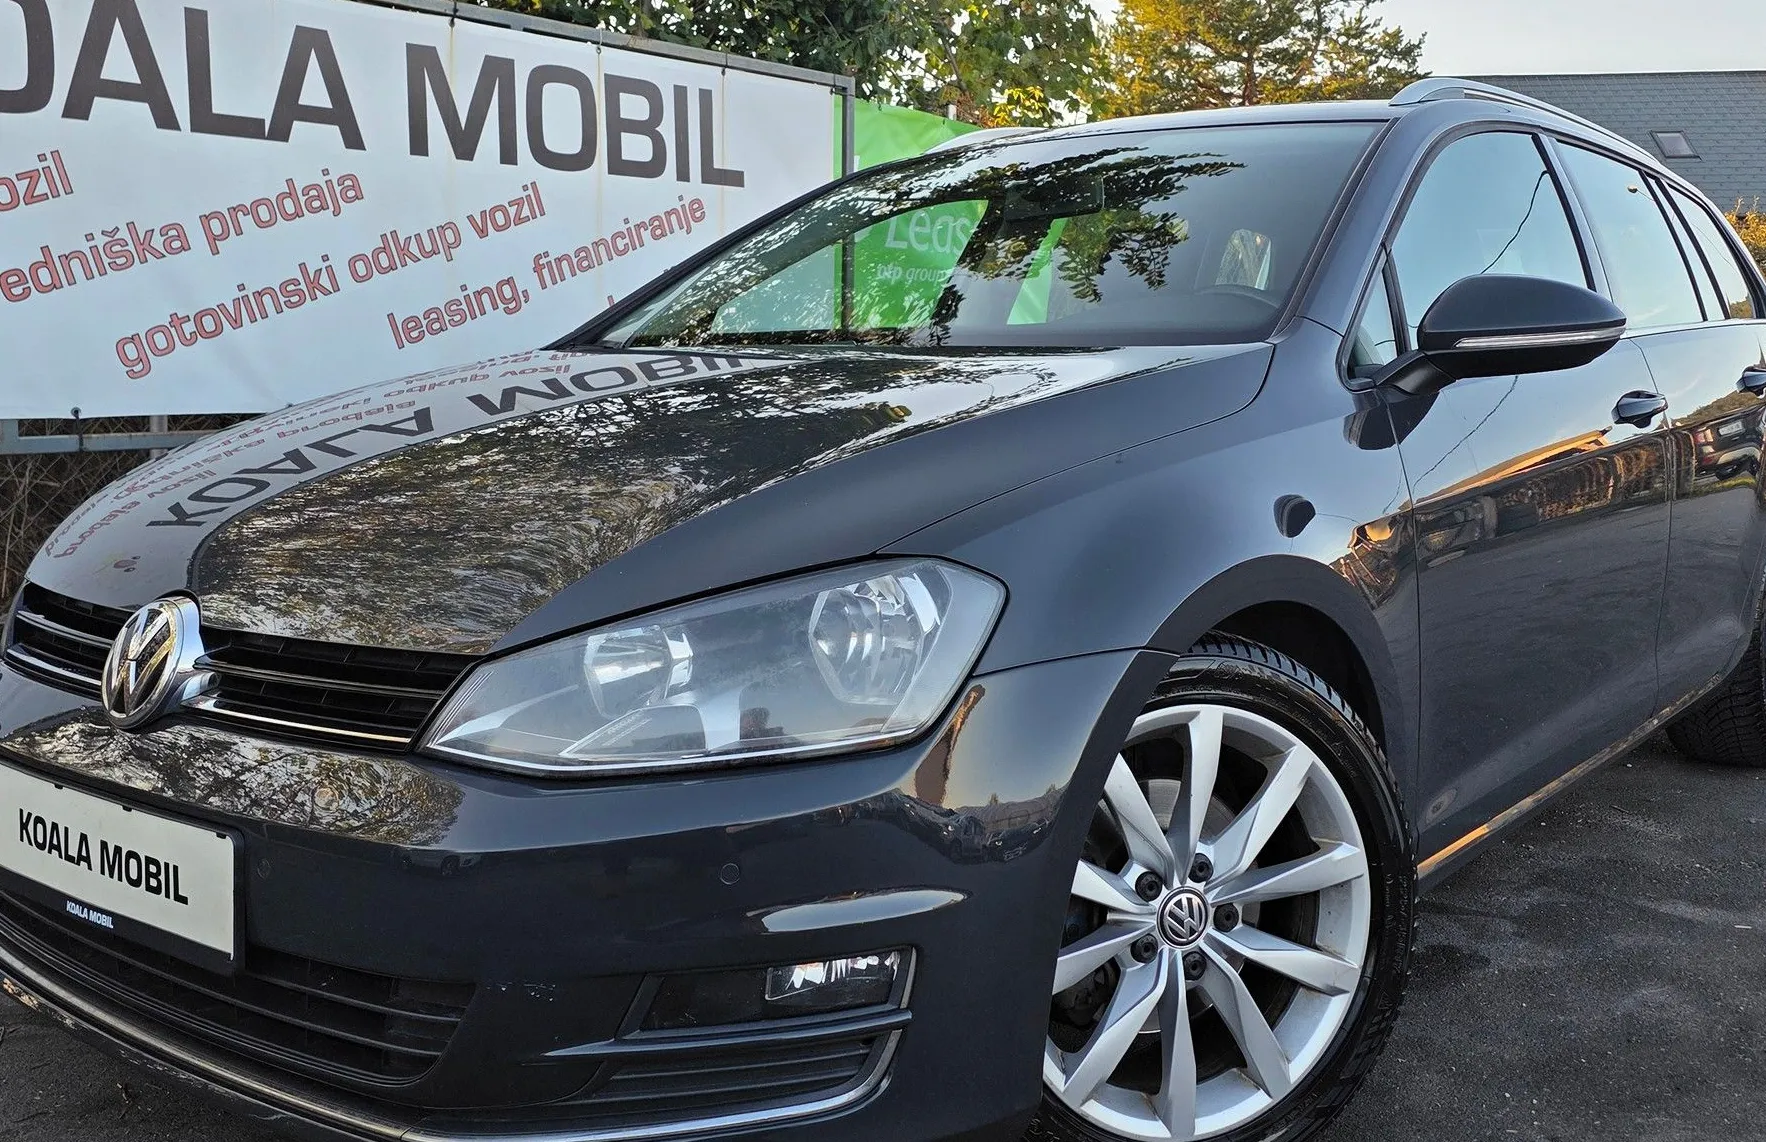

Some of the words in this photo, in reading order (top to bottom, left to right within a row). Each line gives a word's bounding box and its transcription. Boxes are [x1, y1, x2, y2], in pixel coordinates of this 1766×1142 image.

[405, 42, 745, 188] MOBIL
[199, 168, 364, 256] prodaja
[115, 254, 341, 380] gotovinski
[348, 221, 463, 284] odkup
[466, 180, 547, 240] vozil
[386, 276, 531, 350] leasing,
[532, 194, 706, 291] financiranje
[905, 266, 950, 289] group
[19, 807, 93, 872] KOALA
[99, 839, 189, 906] MOBIL
[66, 900, 88, 920] KOALA
[89, 911, 114, 930] MOBIL
